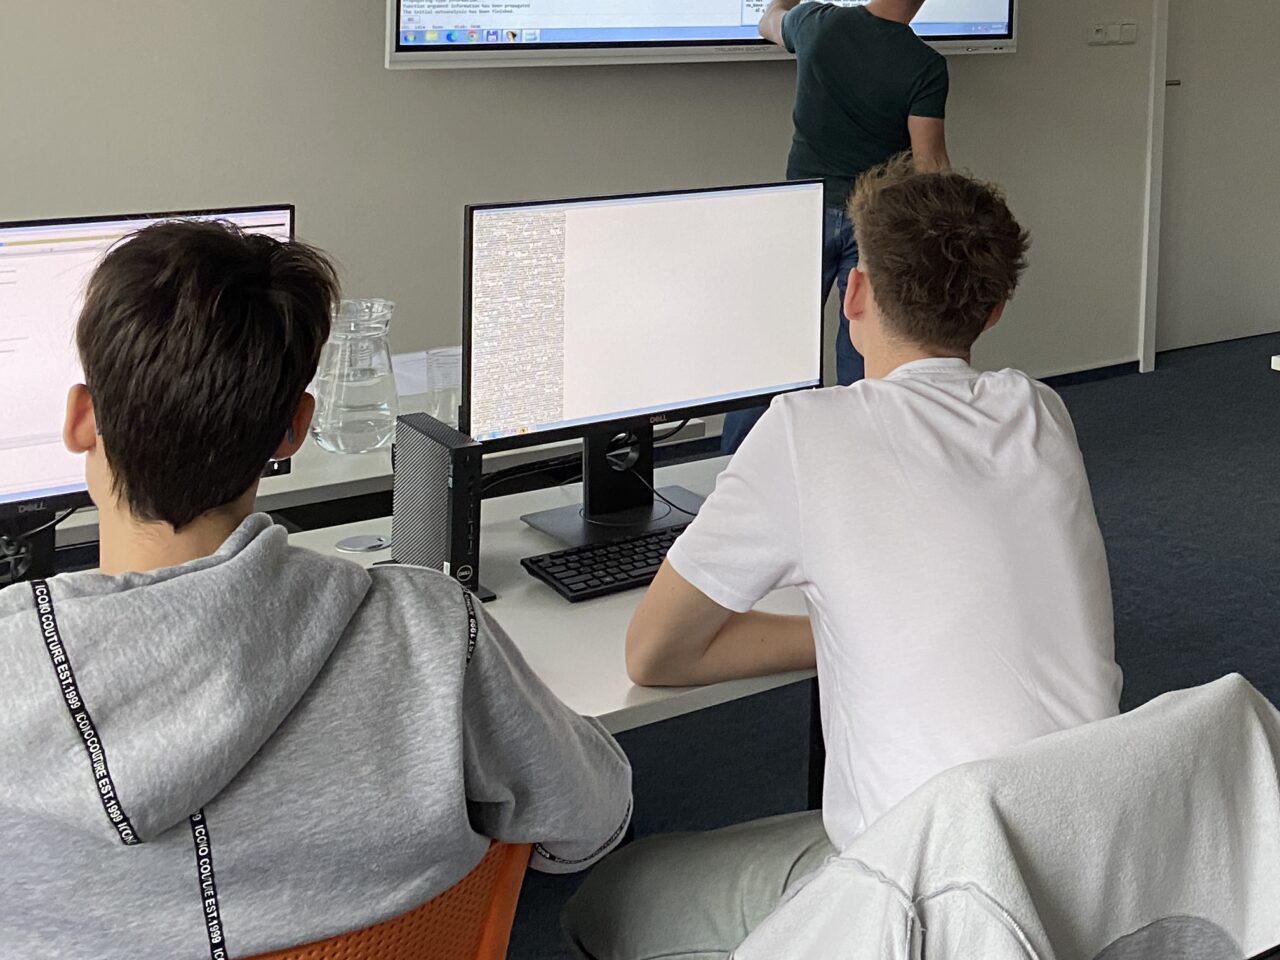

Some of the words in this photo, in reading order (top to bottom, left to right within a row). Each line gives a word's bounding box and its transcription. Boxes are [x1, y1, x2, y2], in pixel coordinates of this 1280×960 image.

[650, 414, 667, 424] DELL
[18, 501, 46, 514] DELL
[42, 614, 66, 665] COUTURE
[56, 664, 81, 710] EST.1999
[86, 737, 108, 780] COUTURE
[98, 777, 124, 822] EST.1999
[199, 858, 214, 898] COUTURE
[204, 898, 222, 944] EST.1999
